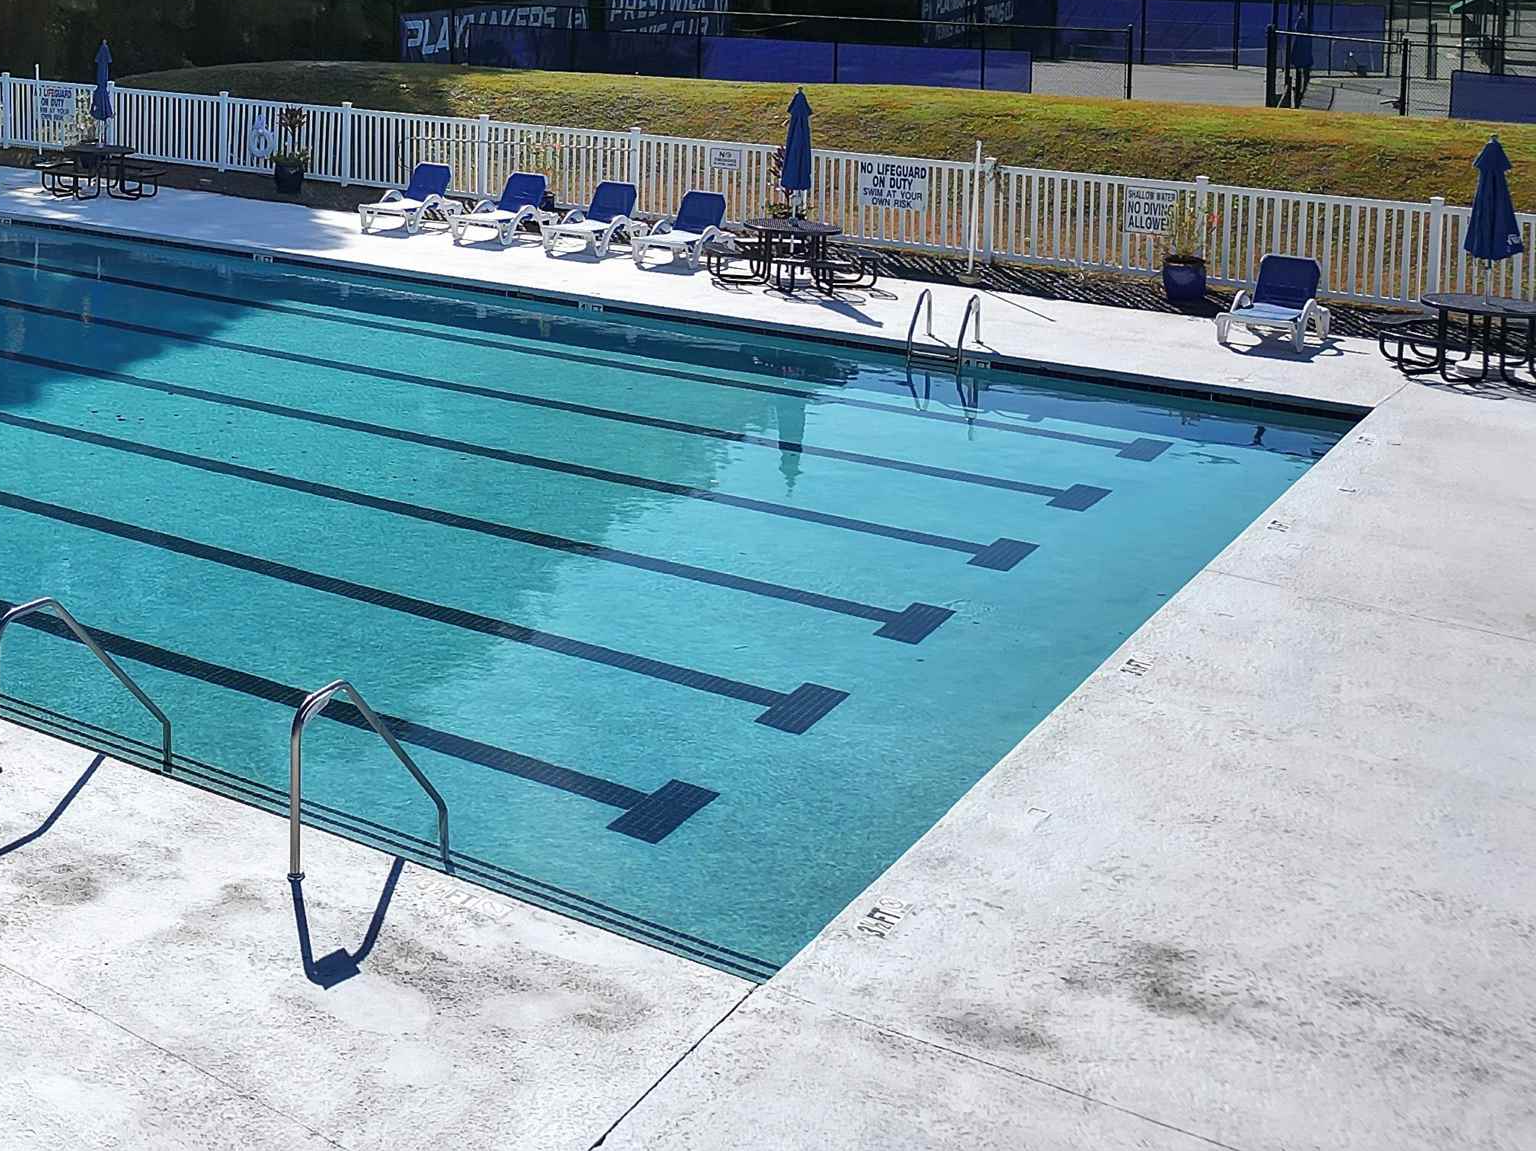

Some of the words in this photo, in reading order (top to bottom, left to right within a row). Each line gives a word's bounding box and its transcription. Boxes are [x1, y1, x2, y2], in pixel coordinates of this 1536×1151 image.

[860, 162, 873, 174] NO
[877, 163, 927, 179] LIFEGUARD
[872, 175, 885, 188] ON
[889, 177, 913, 190] DUTY
[864, 187, 883, 197] SWIM
[886, 190, 897, 198] AT
[901, 191, 923, 201] YOUR
[872, 197, 890, 206] OWN
[894, 199, 913, 209] RISK
[1128, 201, 1141, 214] NO
